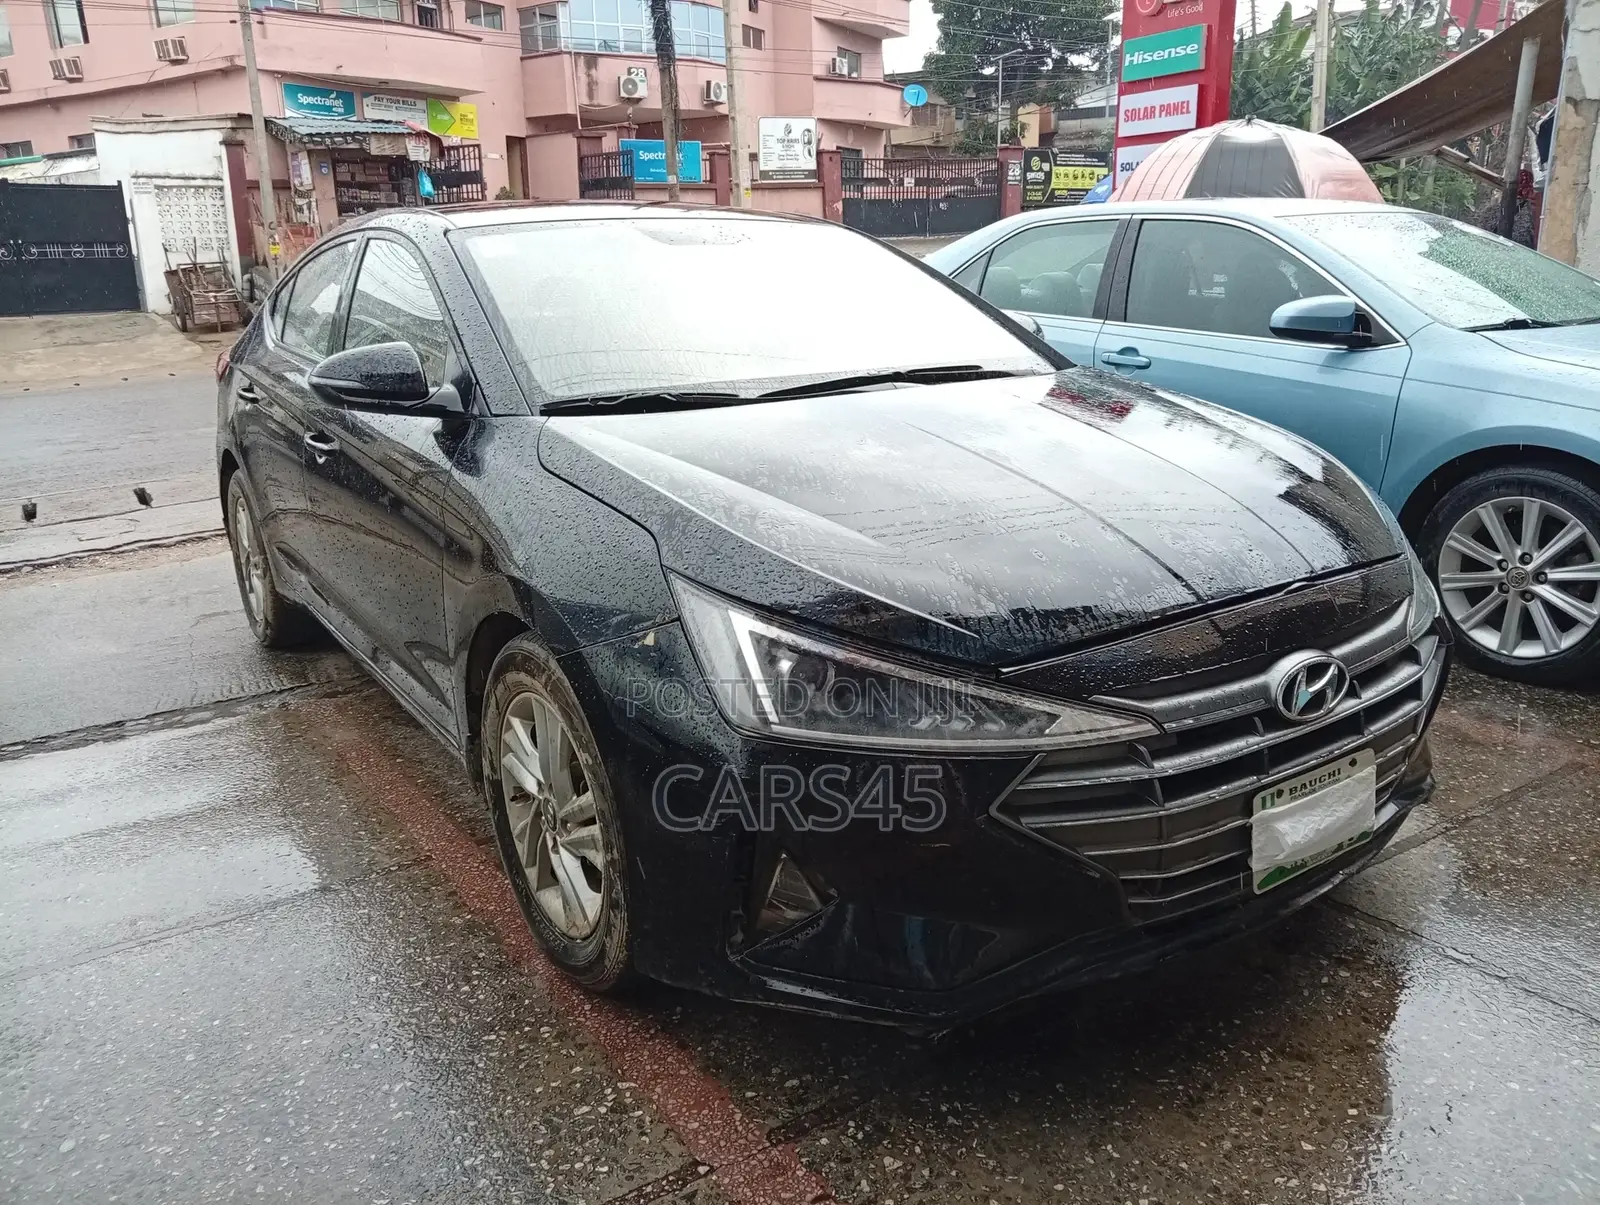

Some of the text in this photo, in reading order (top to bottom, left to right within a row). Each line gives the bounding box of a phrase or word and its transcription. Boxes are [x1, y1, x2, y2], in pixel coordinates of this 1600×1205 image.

[1167, 2, 1203, 18] Life's Good
[1124, 43, 1199, 67] Hisense
[630, 67, 645, 77] 28
[297, 93, 344, 107] Spectranet
[385, 97, 400, 105] YOUR
[402, 99, 417, 107] BILLS
[1123, 100, 1191, 123] SOLAR PANEL
[407, 133, 428, 146] POS
[1008, 163, 1021, 176] 28
[1120, 160, 1143, 172] SOLA
[1288, 767, 1342, 797] BAUCHI
